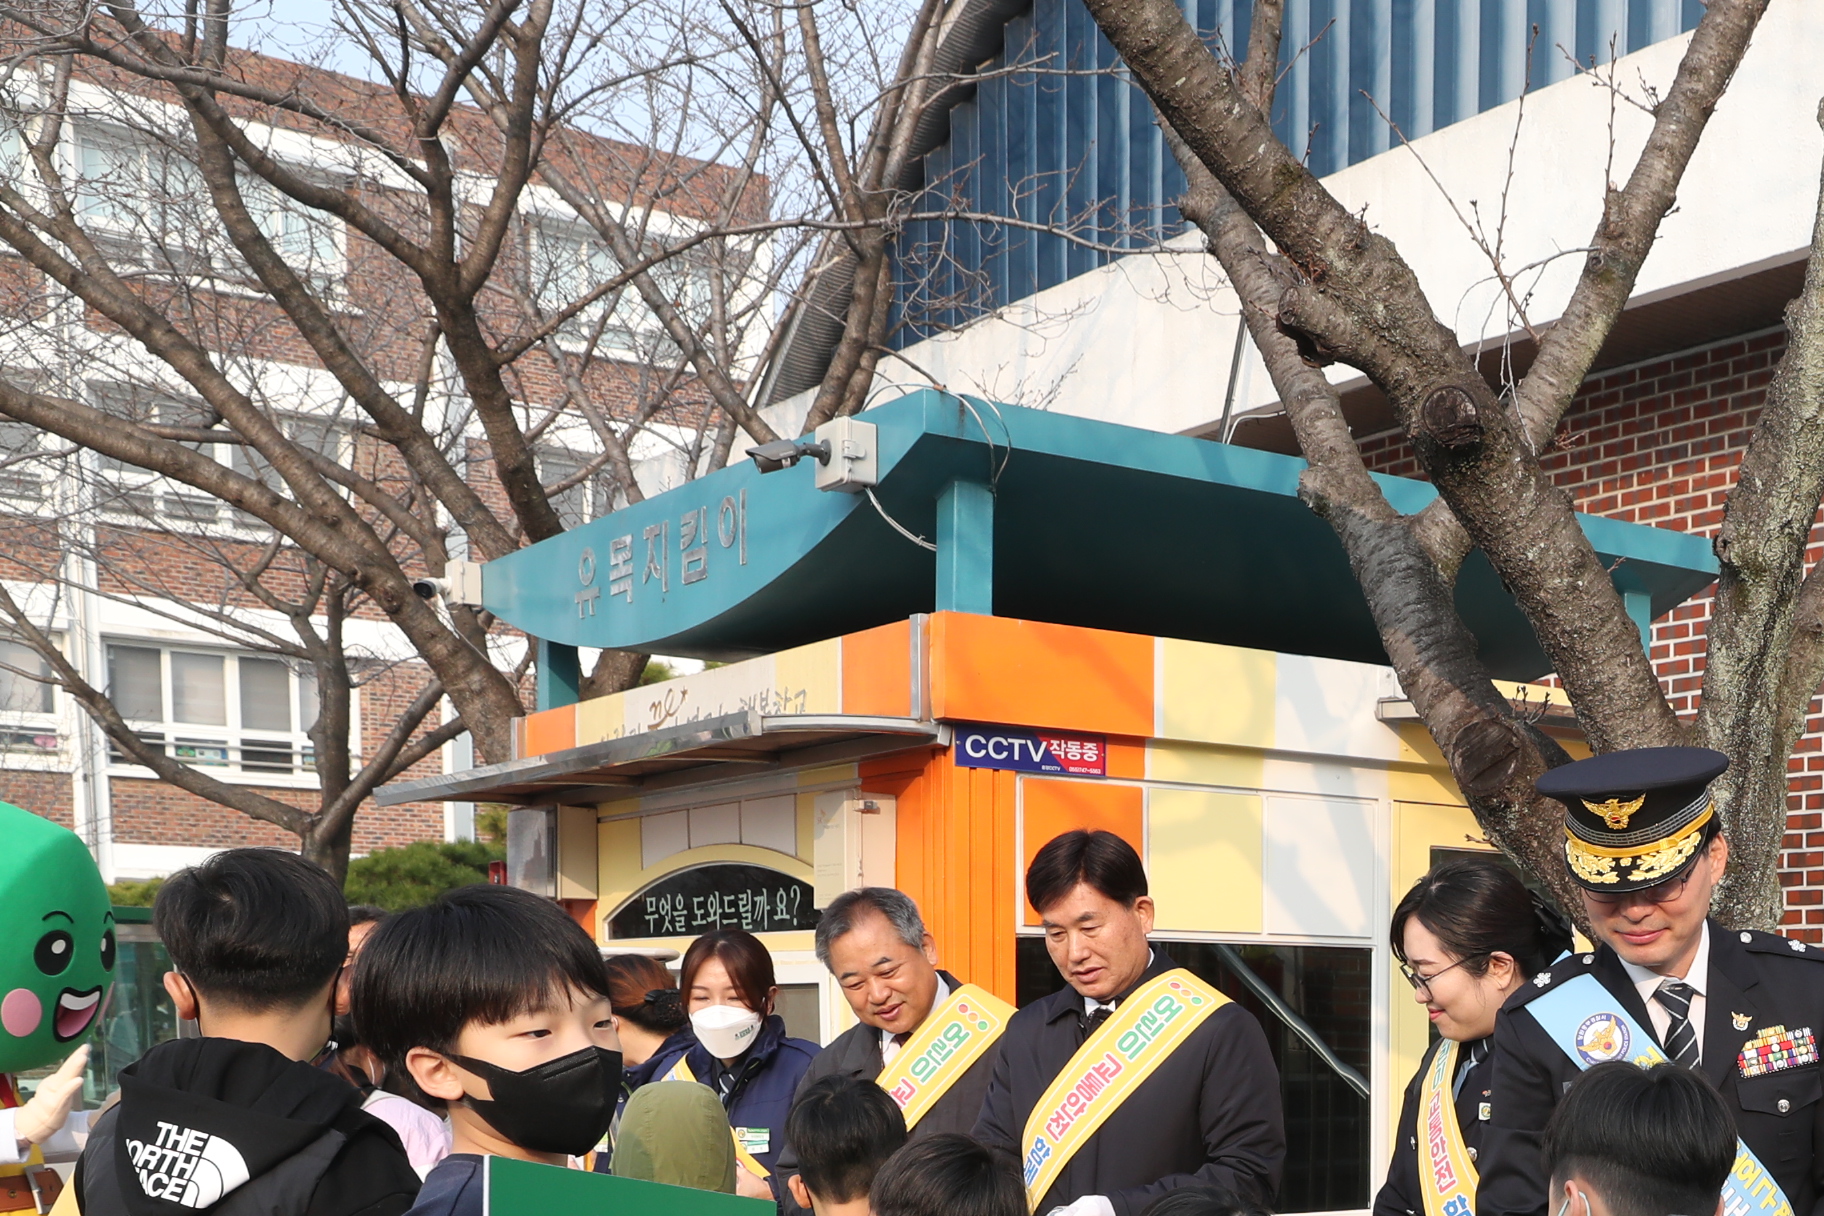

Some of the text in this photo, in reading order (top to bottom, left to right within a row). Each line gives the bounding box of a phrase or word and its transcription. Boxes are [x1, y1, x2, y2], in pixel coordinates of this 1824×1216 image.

[575, 488, 747, 619] 유목지킴이
[965, 735, 1099, 762] CCTV 작동중
[644, 884, 801, 933] 무엇을 도와드릴까 요?
[911, 1022, 970, 1083] 어린이
[1117, 996, 1183, 1060] 어린이
[1045, 1054, 1122, 1141] 교통안전
[116, 1139, 200, 1180] ORTH
[154, 1121, 209, 1157] THE
[1429, 1091, 1457, 1194] 교통안전
[124, 1166, 188, 1203] ACE
